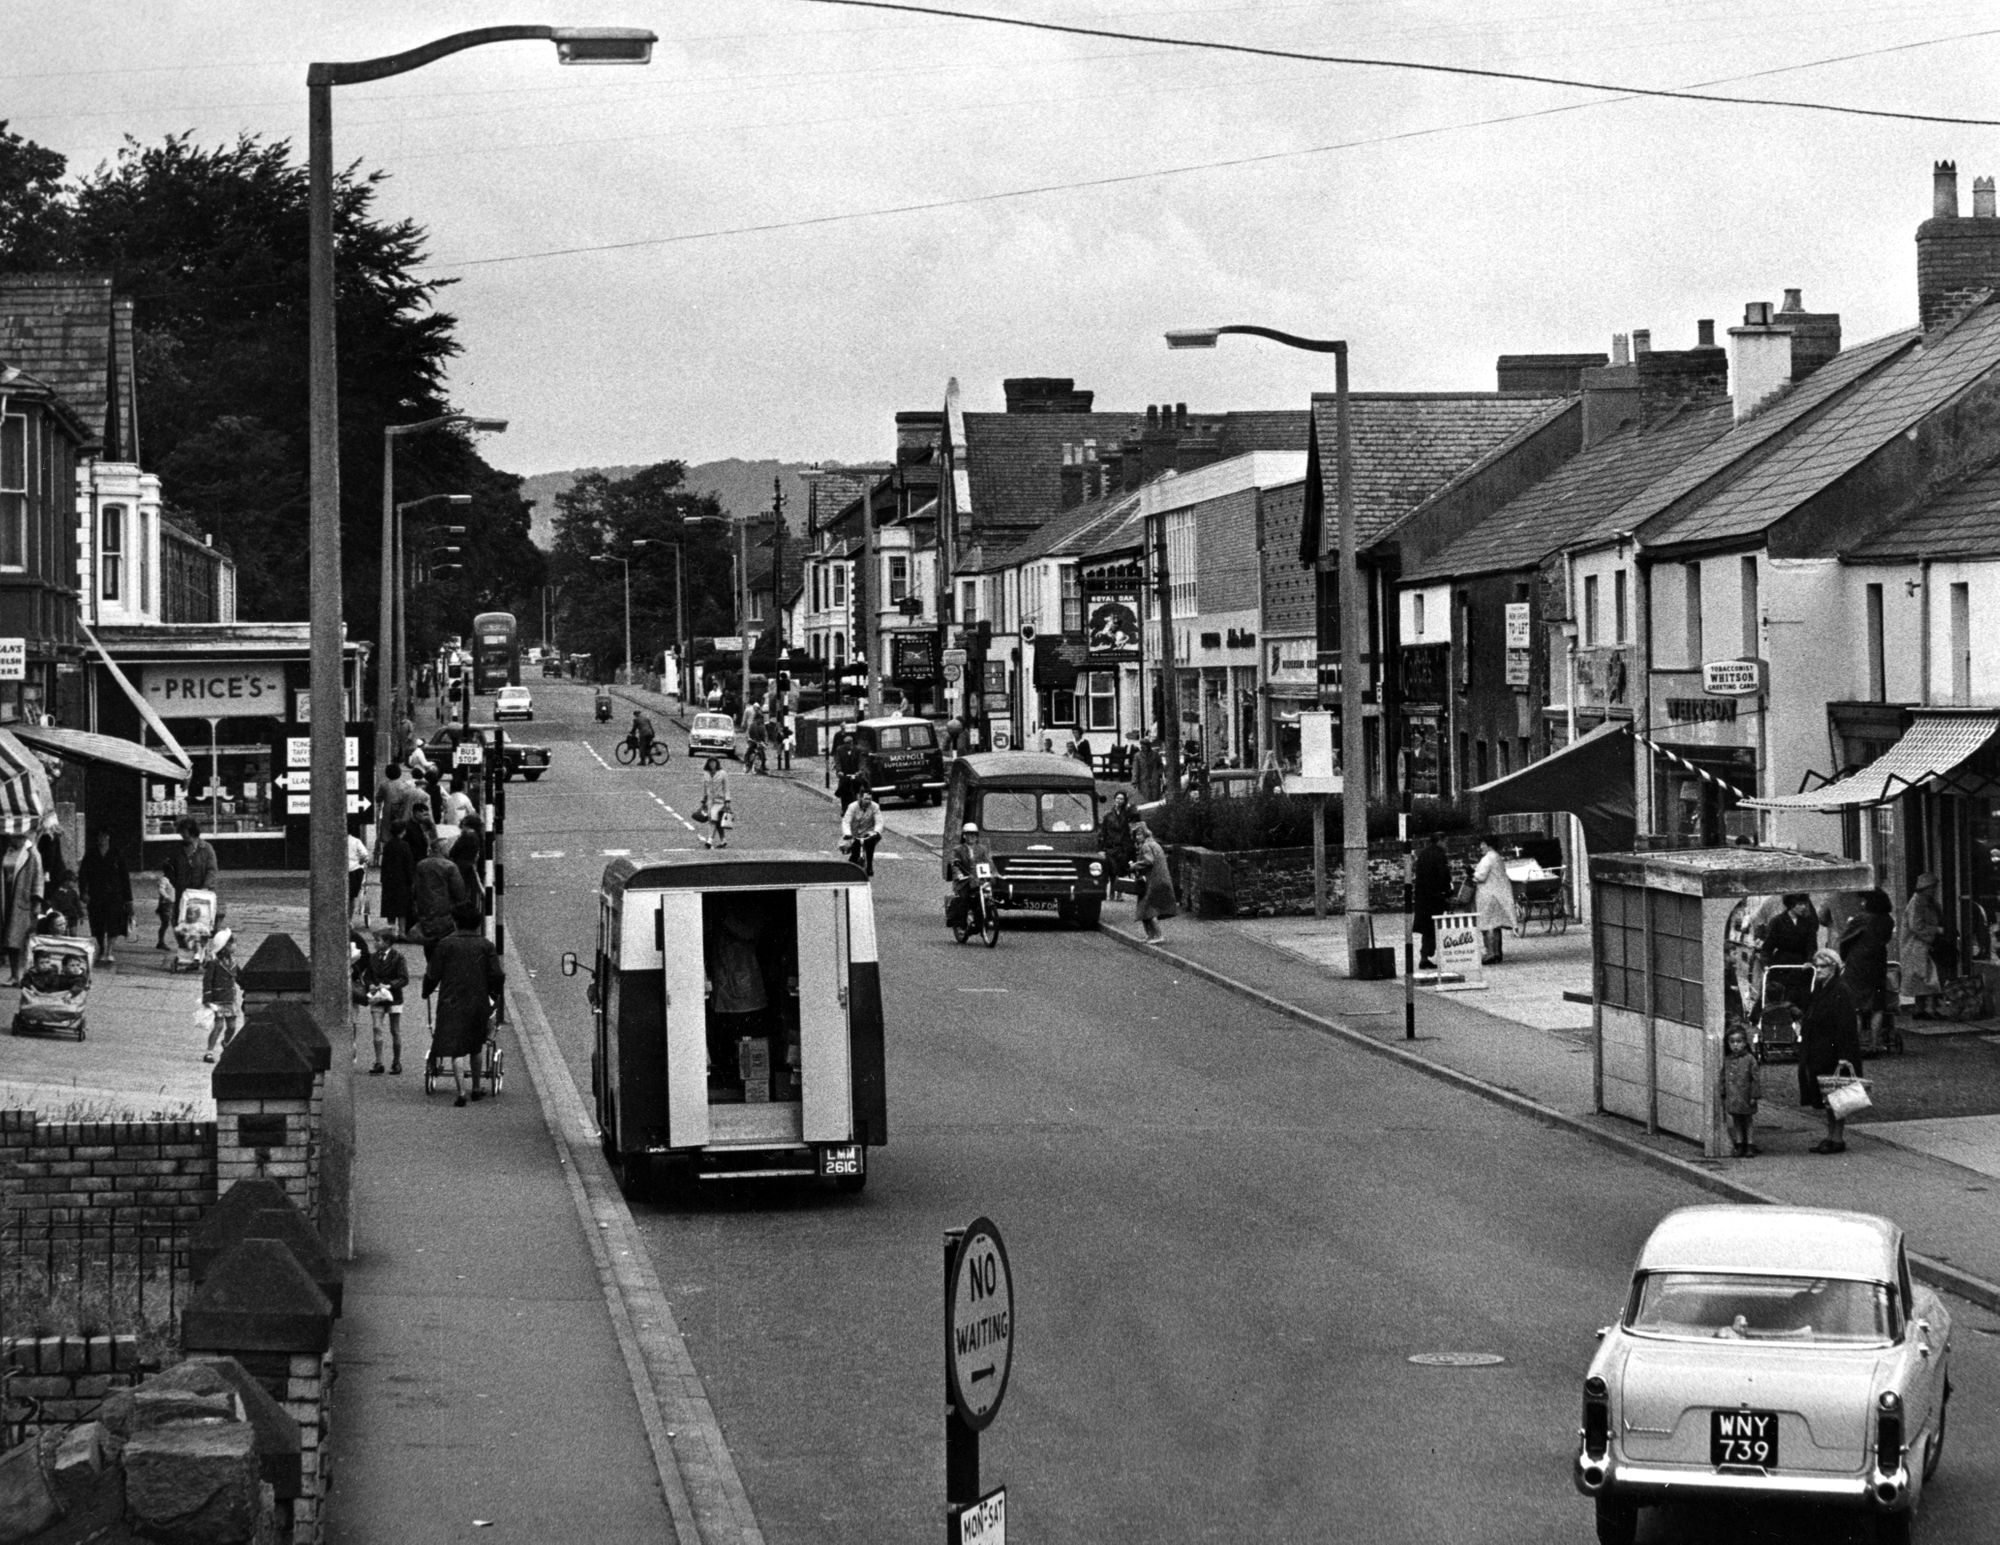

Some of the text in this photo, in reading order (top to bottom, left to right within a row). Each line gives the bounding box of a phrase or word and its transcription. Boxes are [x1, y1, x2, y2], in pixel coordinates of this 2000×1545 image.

[0, 645, 23, 653] AN'S
[1711, 665, 1753, 673] TOBACCONIST
[1710, 672, 1755, 683] WHITSON
[1707, 683, 1737, 691] GREETING
[1666, 698, 1737, 723] WHITSON
[889, 753, 925, 762] MAYPOLE
[826, 1160, 858, 1174] 261C
[970, 1252, 996, 1302] NO
[956, 1311, 1008, 1356] WAITING
[1720, 1415, 1769, 1437] WNY
[1720, 1440, 1769, 1462] 739
